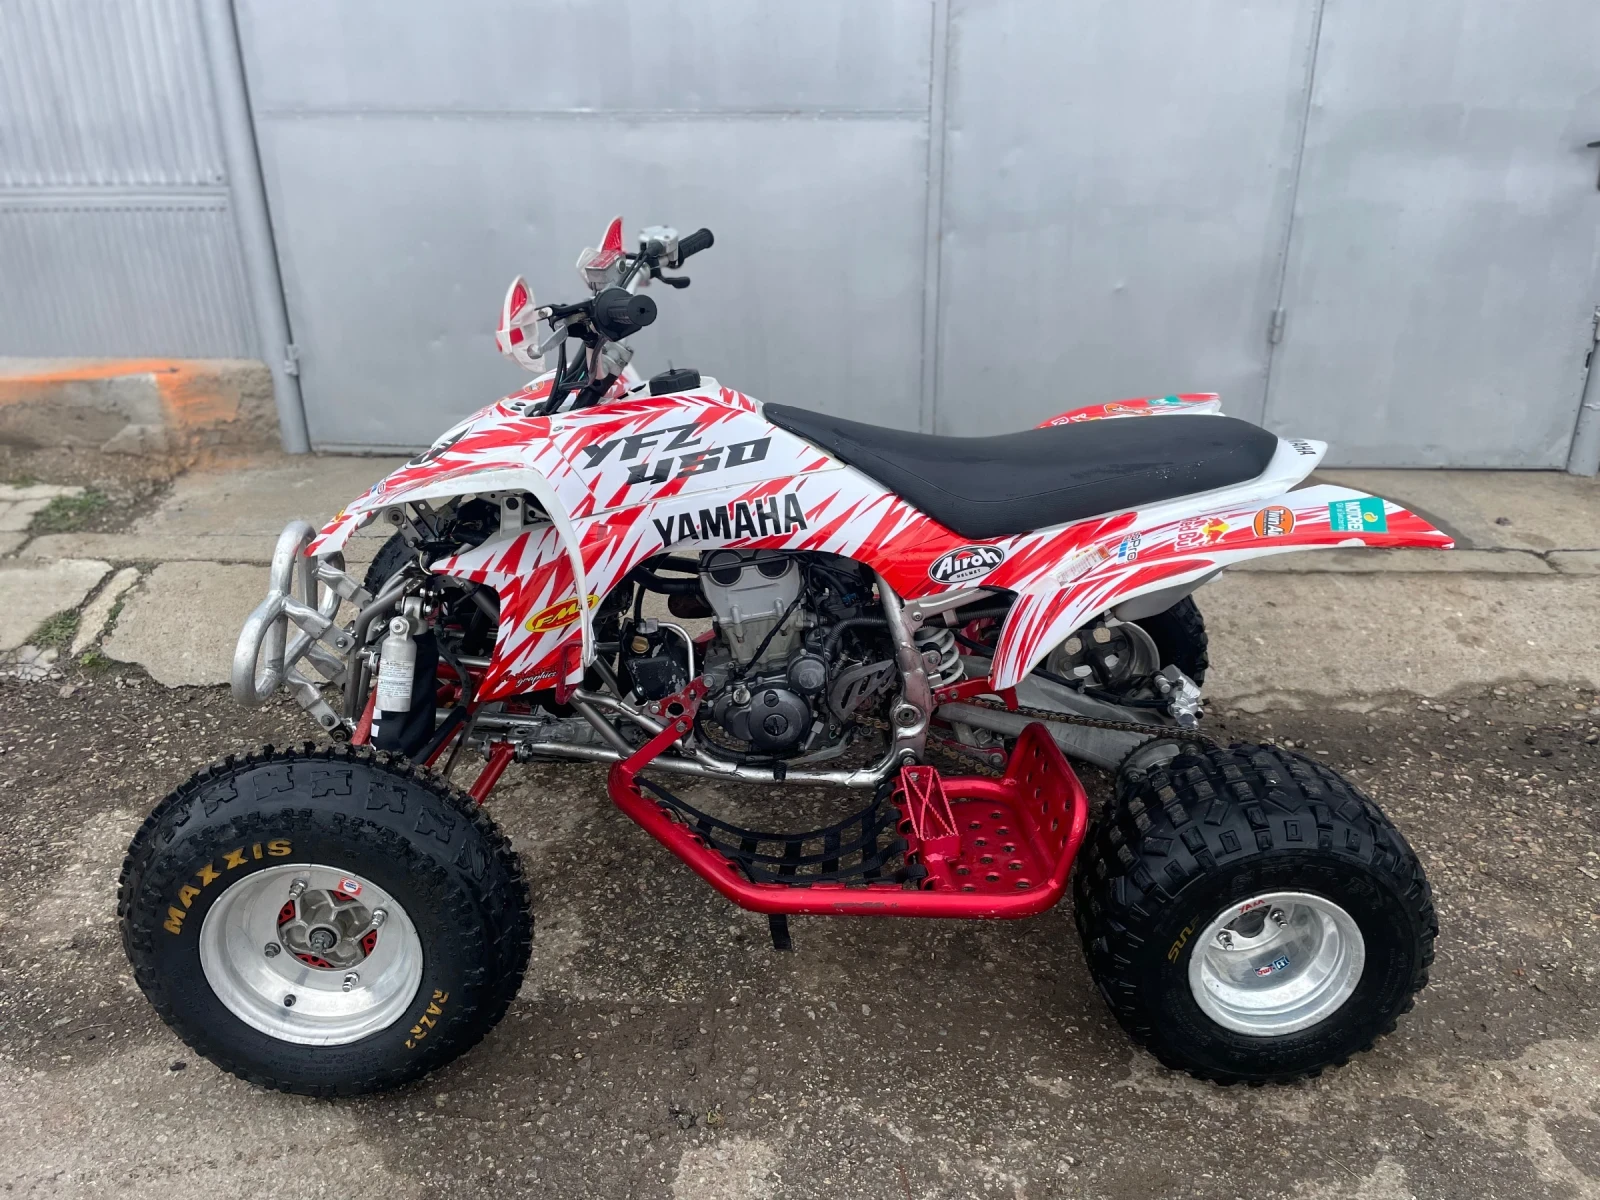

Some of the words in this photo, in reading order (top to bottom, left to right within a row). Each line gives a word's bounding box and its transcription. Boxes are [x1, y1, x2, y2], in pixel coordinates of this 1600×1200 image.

[582, 422, 702, 470] YFZ
[626, 437, 772, 485] 450
[653, 493, 807, 548] YAMAHA
[936, 548, 1001, 579] Airoh
[956, 568, 981, 578] HELMET
[164, 839, 293, 935] MAXXIS
